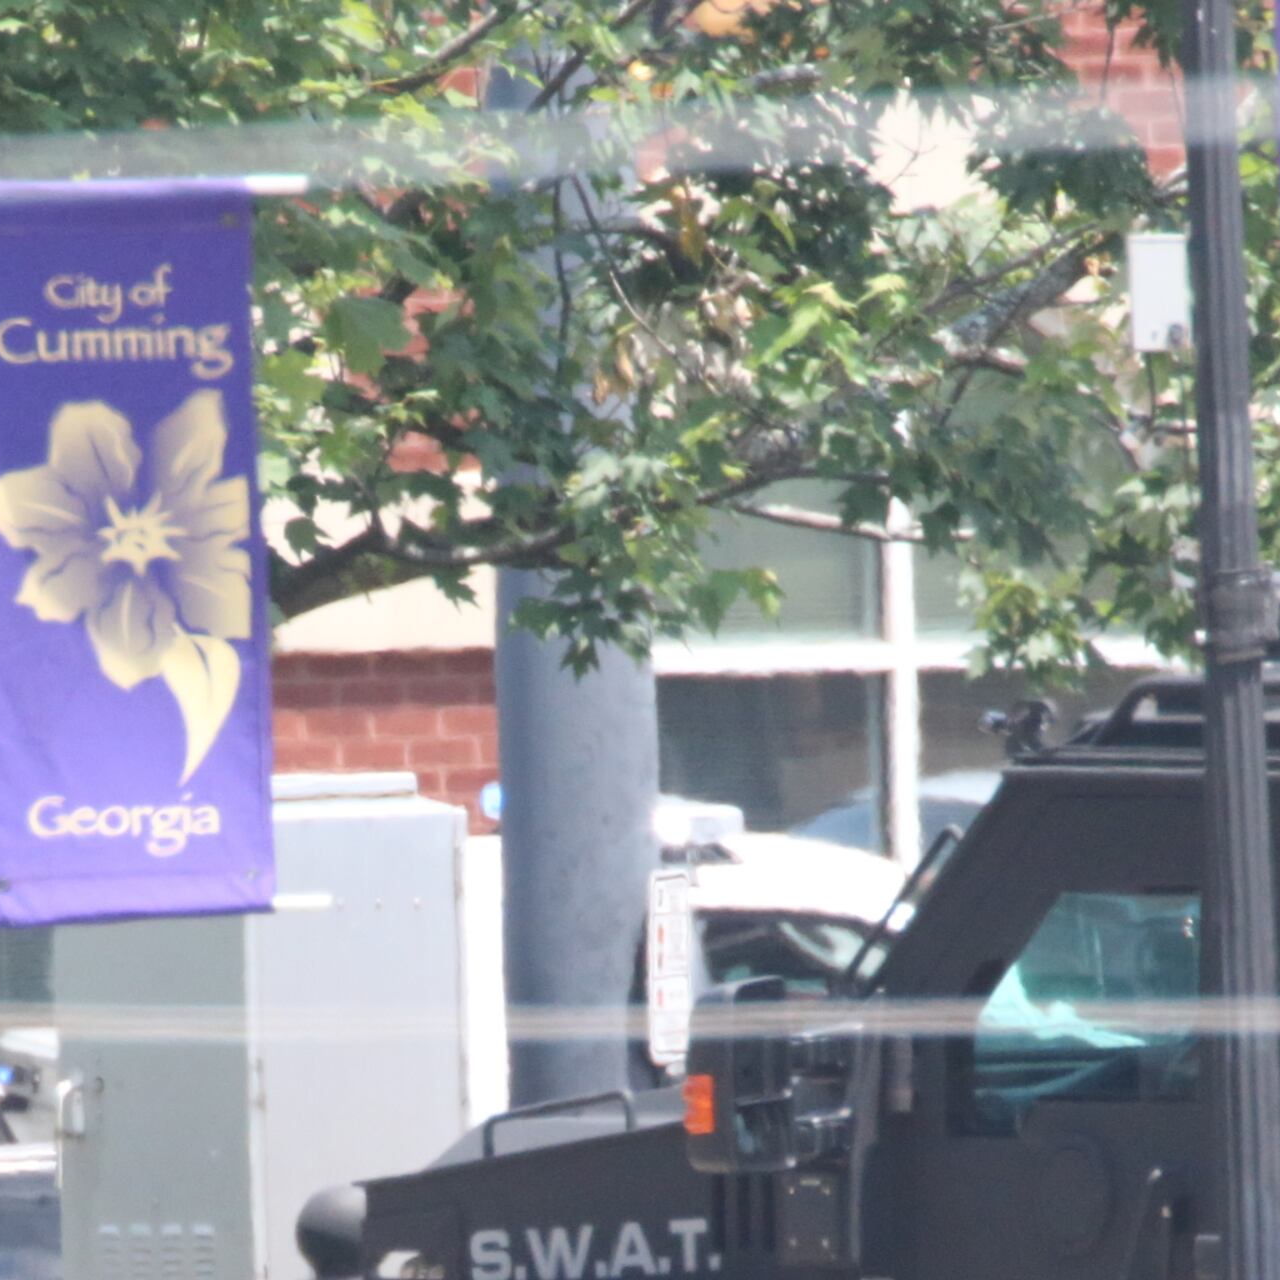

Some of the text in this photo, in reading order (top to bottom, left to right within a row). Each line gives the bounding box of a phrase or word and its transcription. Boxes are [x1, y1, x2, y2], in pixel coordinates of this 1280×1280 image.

[43, 262, 173, 324] City of
[28, 792, 221, 857] Georgia
